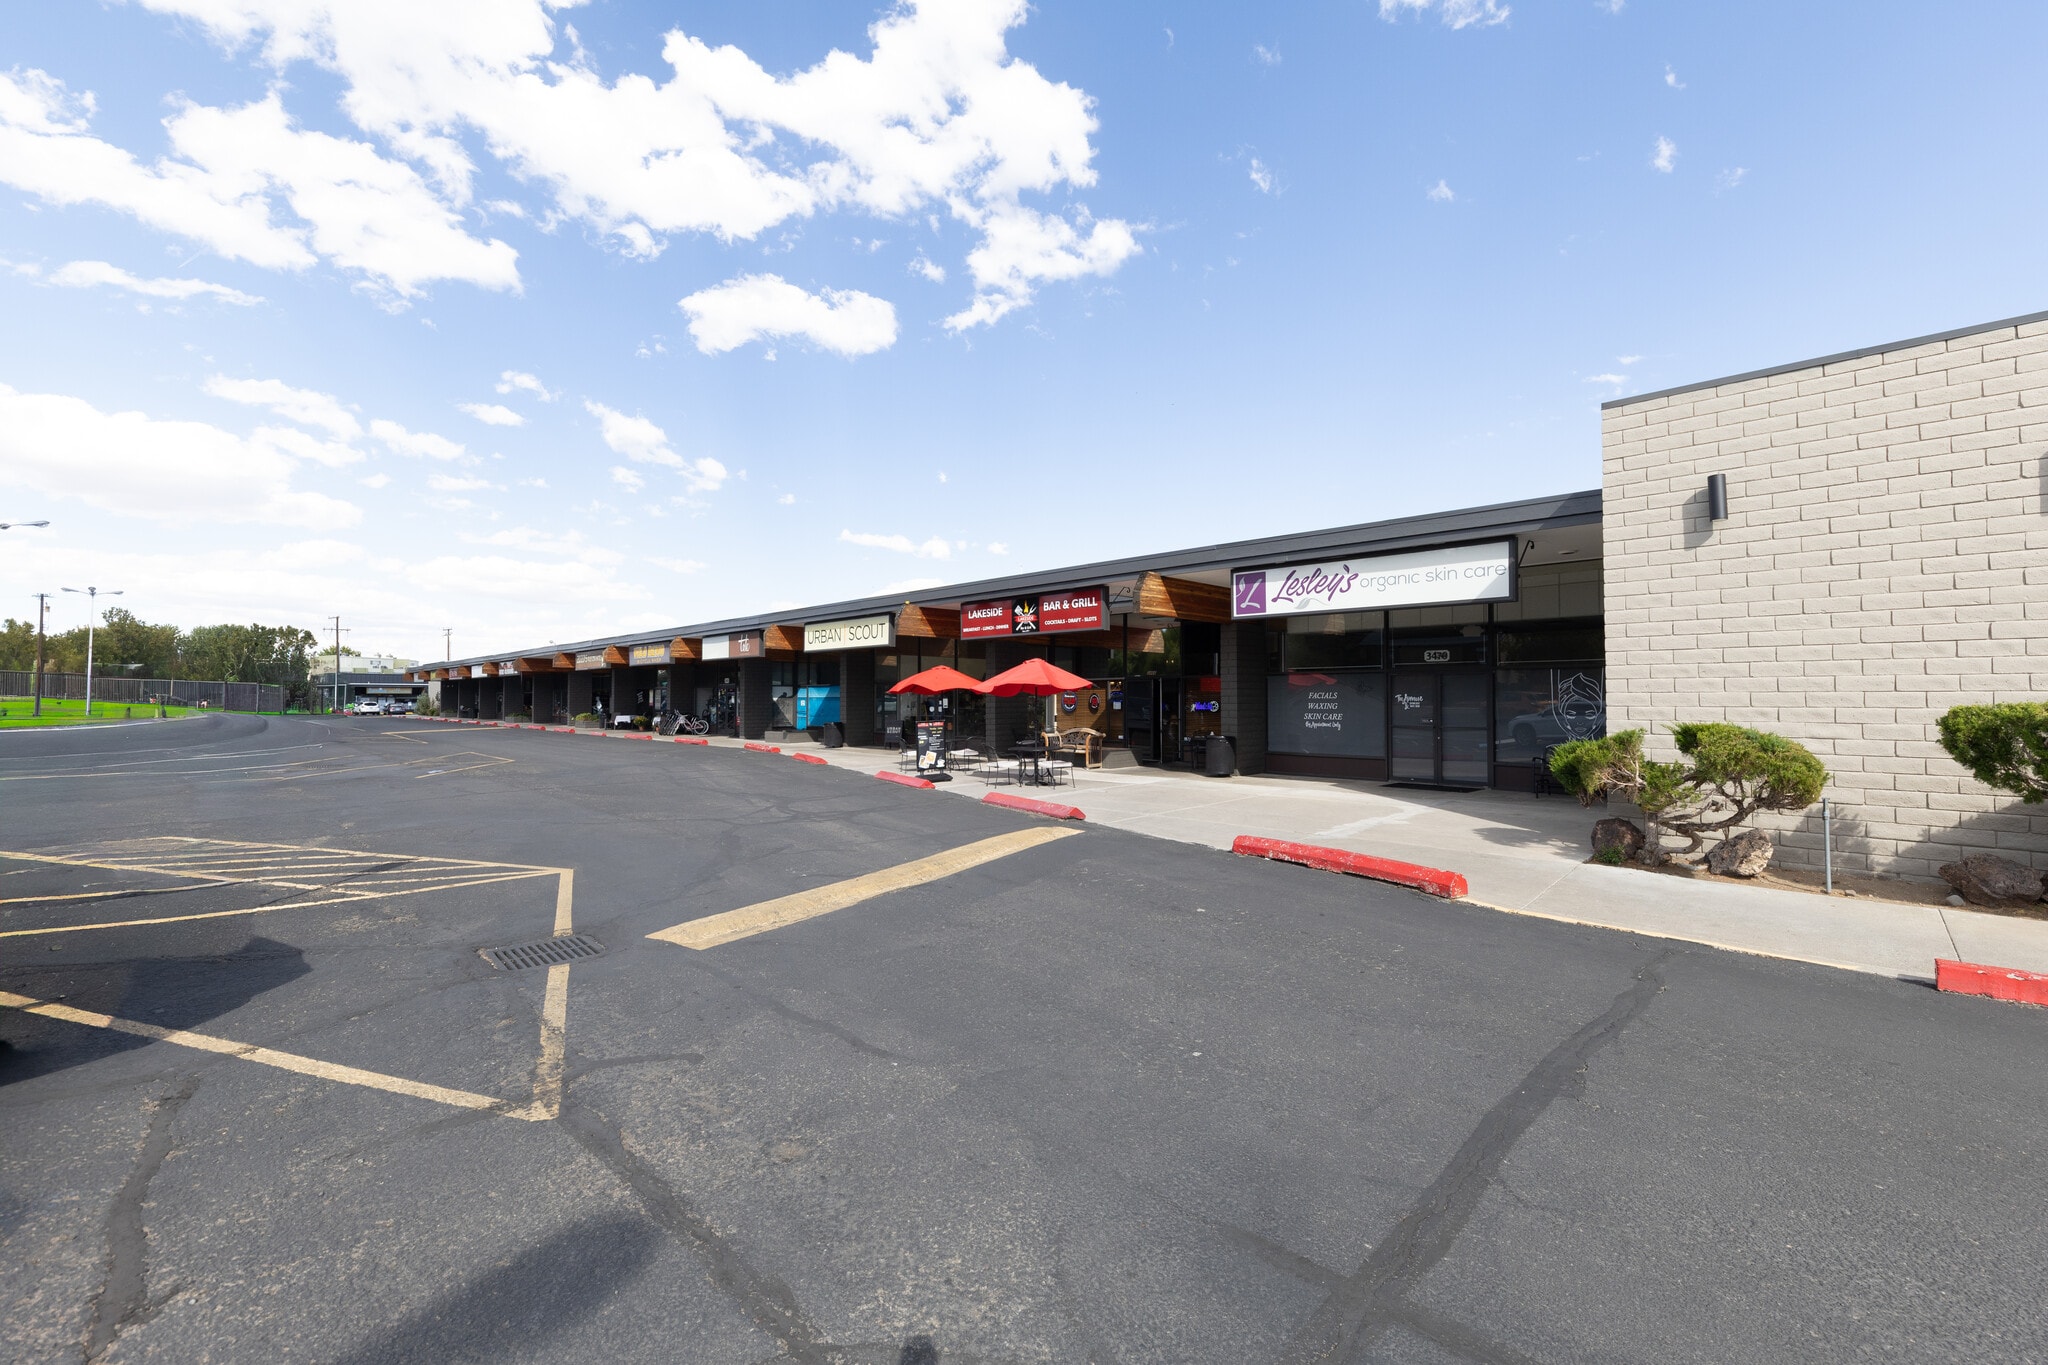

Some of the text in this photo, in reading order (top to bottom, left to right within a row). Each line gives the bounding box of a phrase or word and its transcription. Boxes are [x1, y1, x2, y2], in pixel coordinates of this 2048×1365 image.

[1271, 564, 1507, 604] Lesley's organic skin care
[1043, 597, 1098, 612] BAR & GRILL
[968, 607, 1003, 620] LAKESIDE
[807, 622, 886, 645] URBAN SCOUT
[1308, 702, 1338, 710] WAXING
